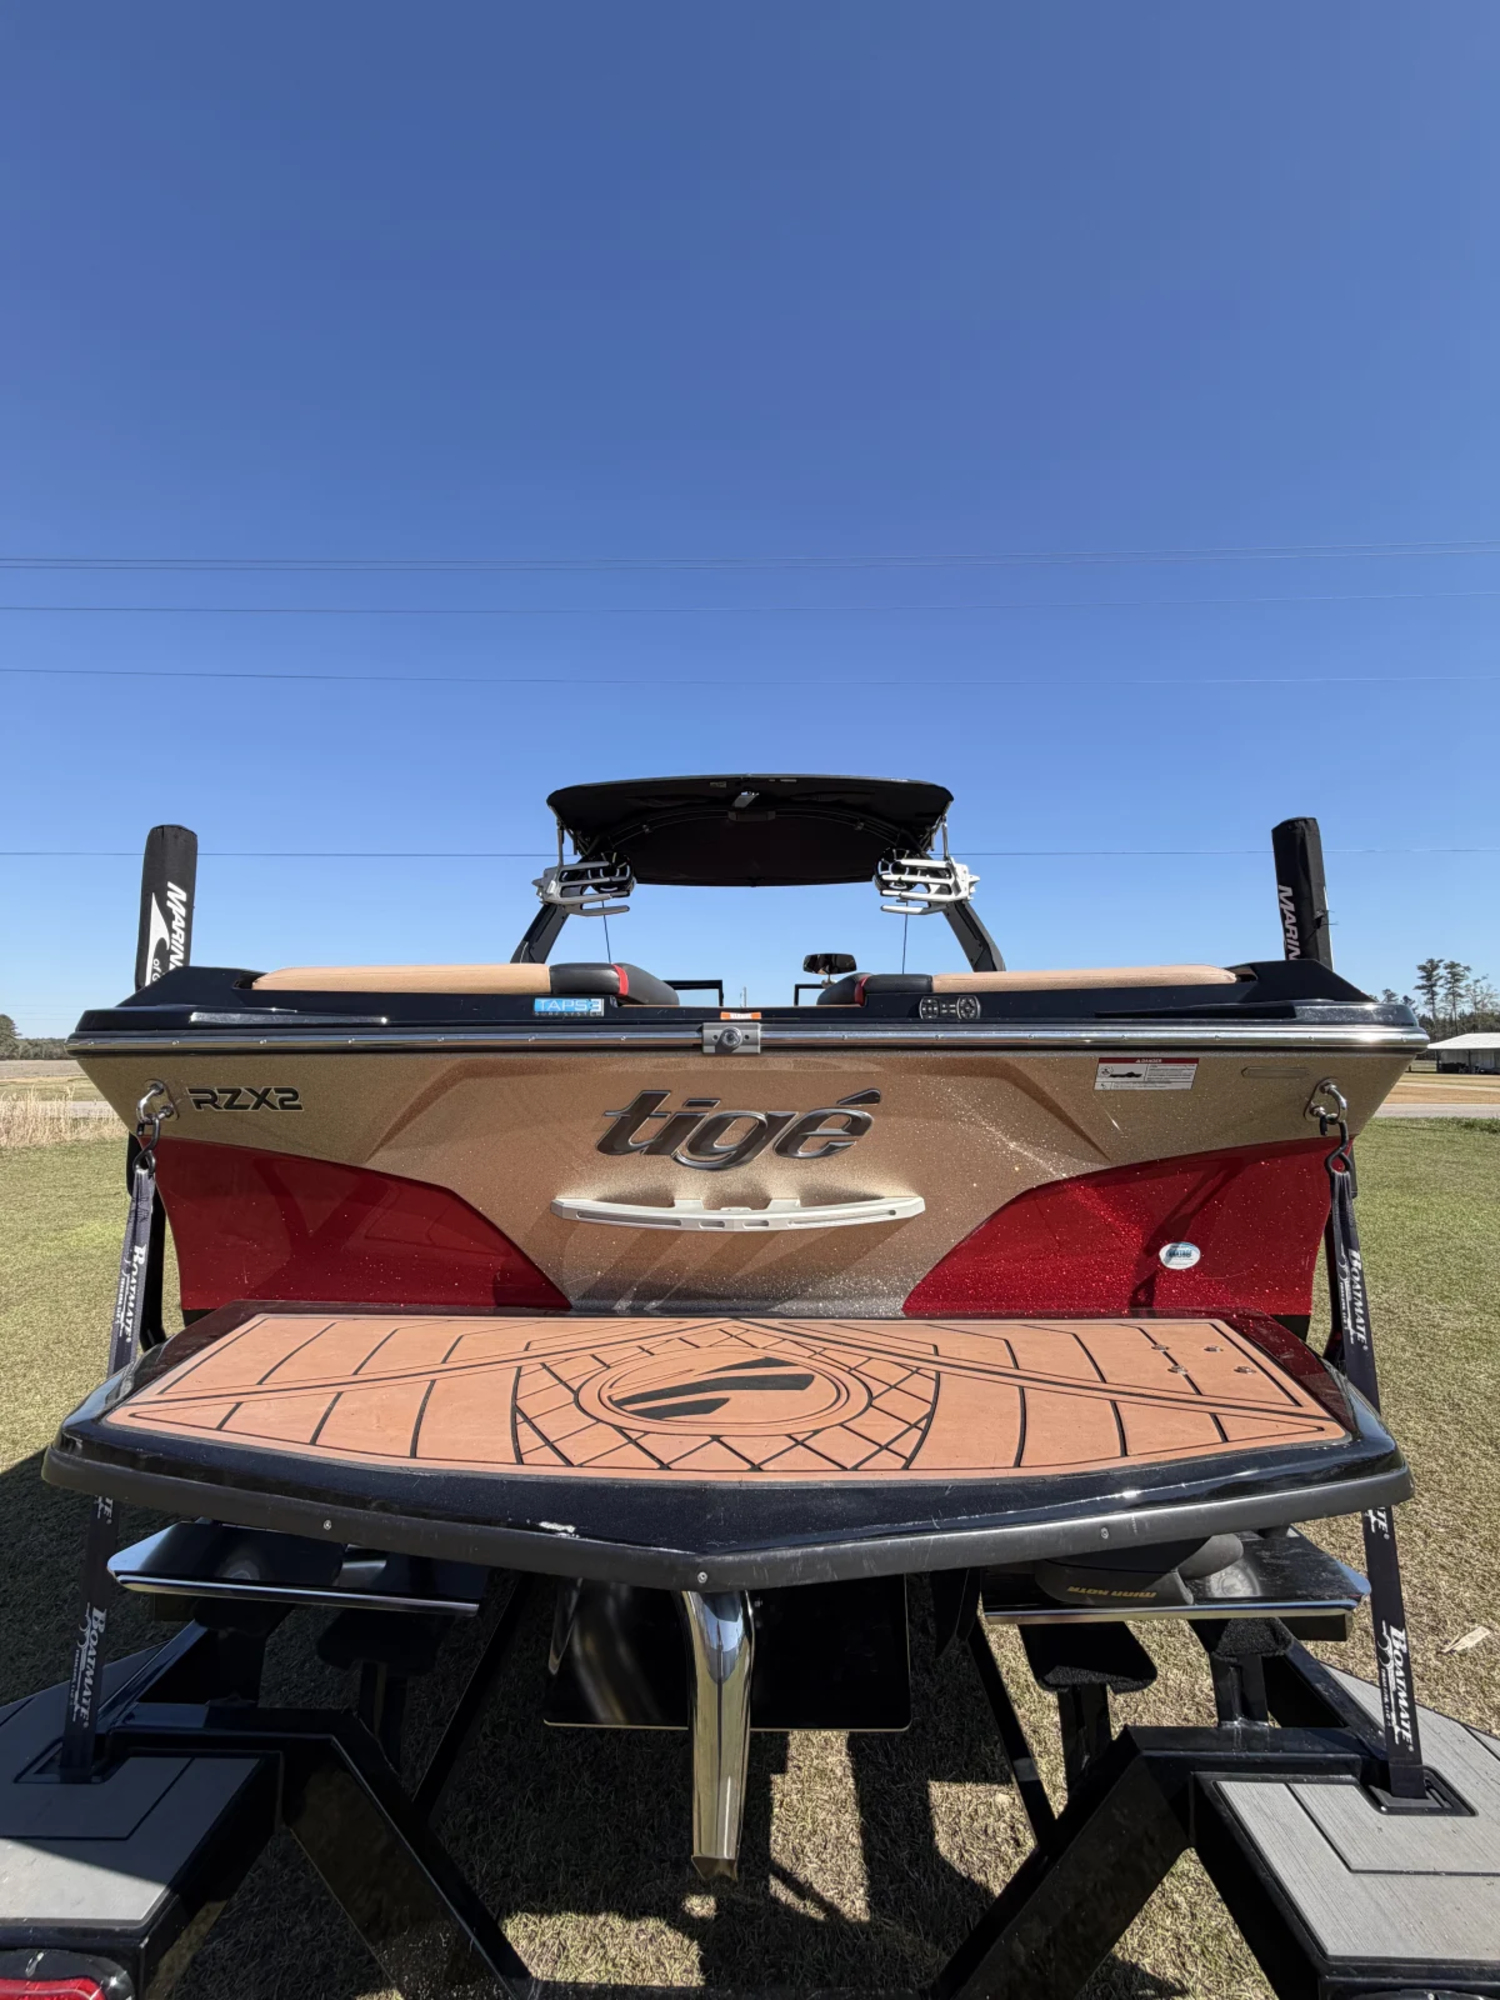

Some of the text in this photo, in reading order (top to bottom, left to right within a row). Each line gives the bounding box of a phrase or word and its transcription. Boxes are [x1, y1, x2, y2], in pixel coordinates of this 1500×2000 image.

[166, 881, 187, 971] MARIN
[186, 1086, 304, 1112] RZX2
[595, 1087, 882, 1171] tigé
